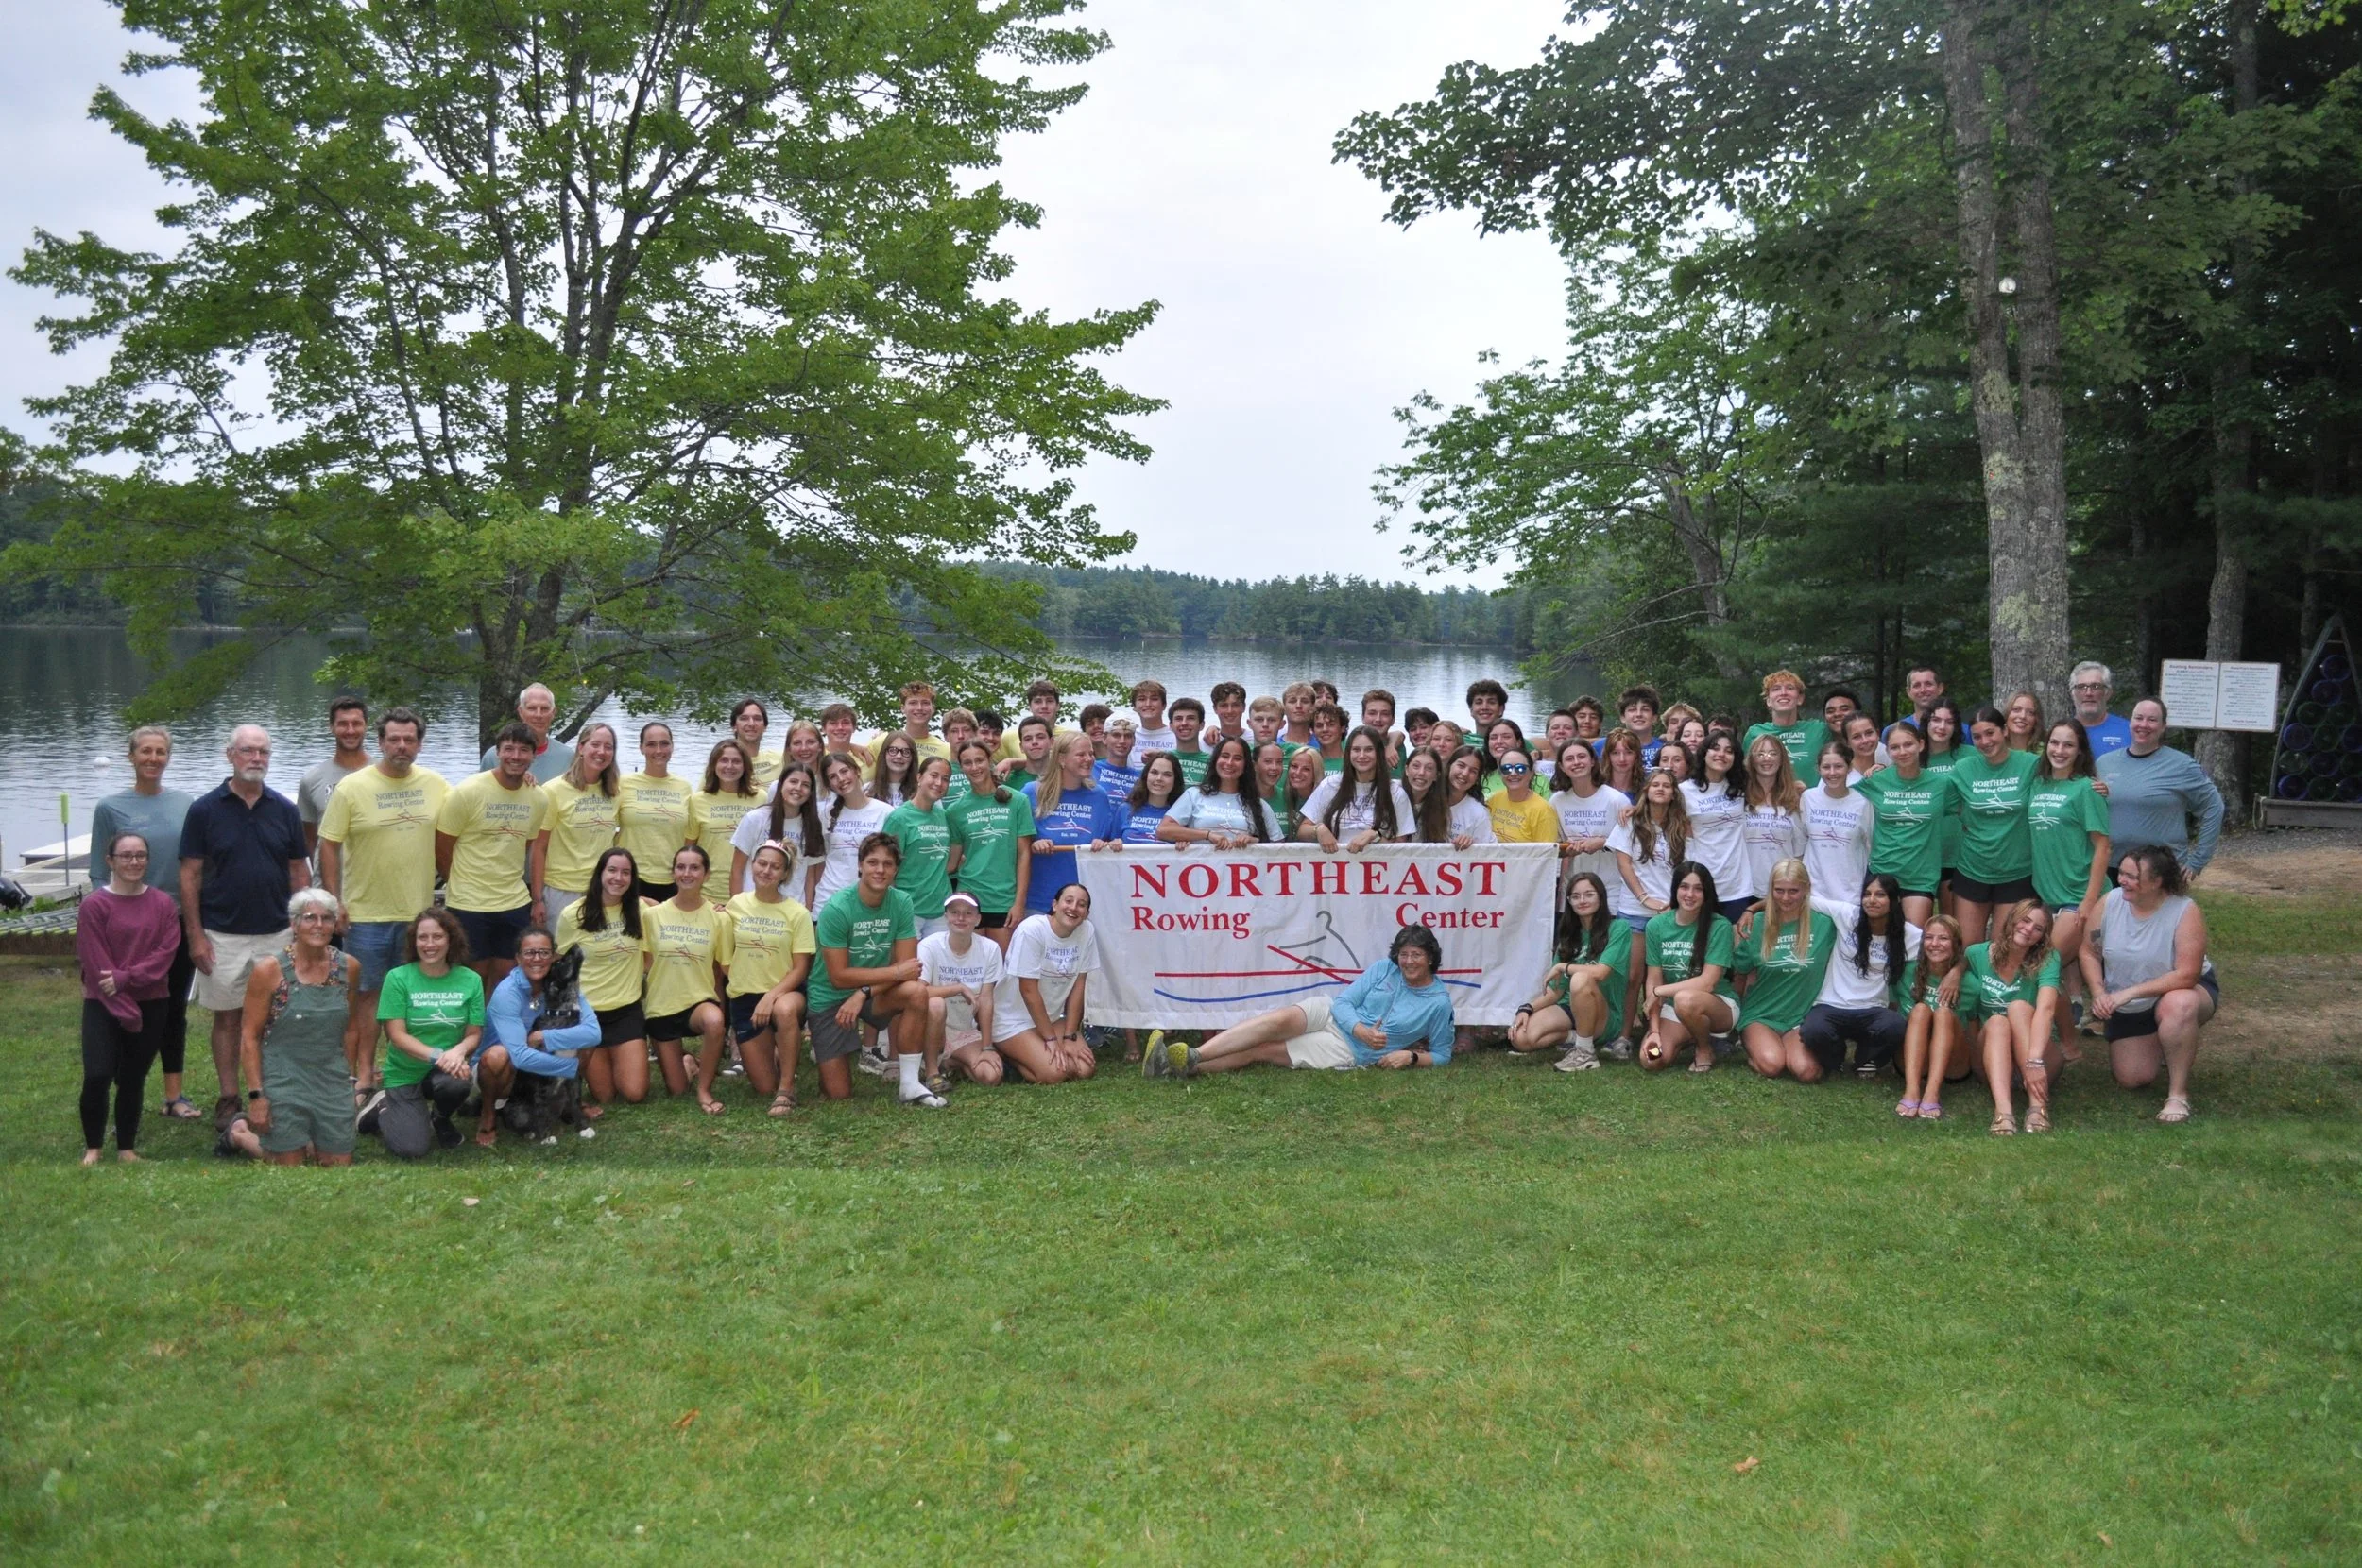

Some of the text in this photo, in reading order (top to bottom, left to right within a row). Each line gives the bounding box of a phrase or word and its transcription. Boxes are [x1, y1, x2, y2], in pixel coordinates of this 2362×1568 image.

[1972, 776, 2020, 788] NORTHEAST
[636, 790, 681, 800] NORTHEAST
[1883, 791, 1931, 799] NORTHEAST
[1973, 786, 1996, 794] Rowing
[376, 790, 424, 802] NORTHEAST
[574, 794, 613, 805] NORTHEAST
[2031, 793, 2067, 802] NORTHEAST
[378, 798, 426, 810] Rowing Center
[637, 797, 660, 806] Rowing
[486, 802, 530, 813] NORTHEAST
[575, 805, 596, 813] Rowing
[1700, 804, 1723, 814] Rowing
[486, 811, 530, 822] Rowing Center
[710, 812, 735, 821] Rowing
[967, 809, 1011, 822] NORTHEAST
[990, 814, 1009, 823] Center
[1071, 811, 1092, 820] Center
[1564, 810, 1607, 819] NORTHEAST
[1809, 809, 1858, 822] NORTHEAST
[1564, 818, 1607, 827] Rowing Center
[1772, 821, 1793, 830] Center
[1809, 818, 1857, 829] Rowing Center
[1129, 861, 1506, 898] NORTHEAST
[1395, 902, 1504, 929] Center
[740, 917, 786, 929] NORTHEAST
[1130, 907, 1251, 939] Rowing
[659, 925, 710, 937] NORTHEAST
[739, 926, 784, 937] Rowing Center
[659, 933, 710, 946] Rowing Center
[939, 966, 984, 976] NORTHEAST
[938, 974, 984, 983] Rowing Center
[411, 992, 465, 1001] NORTHEAST
[413, 999, 439, 1008] Rowing
